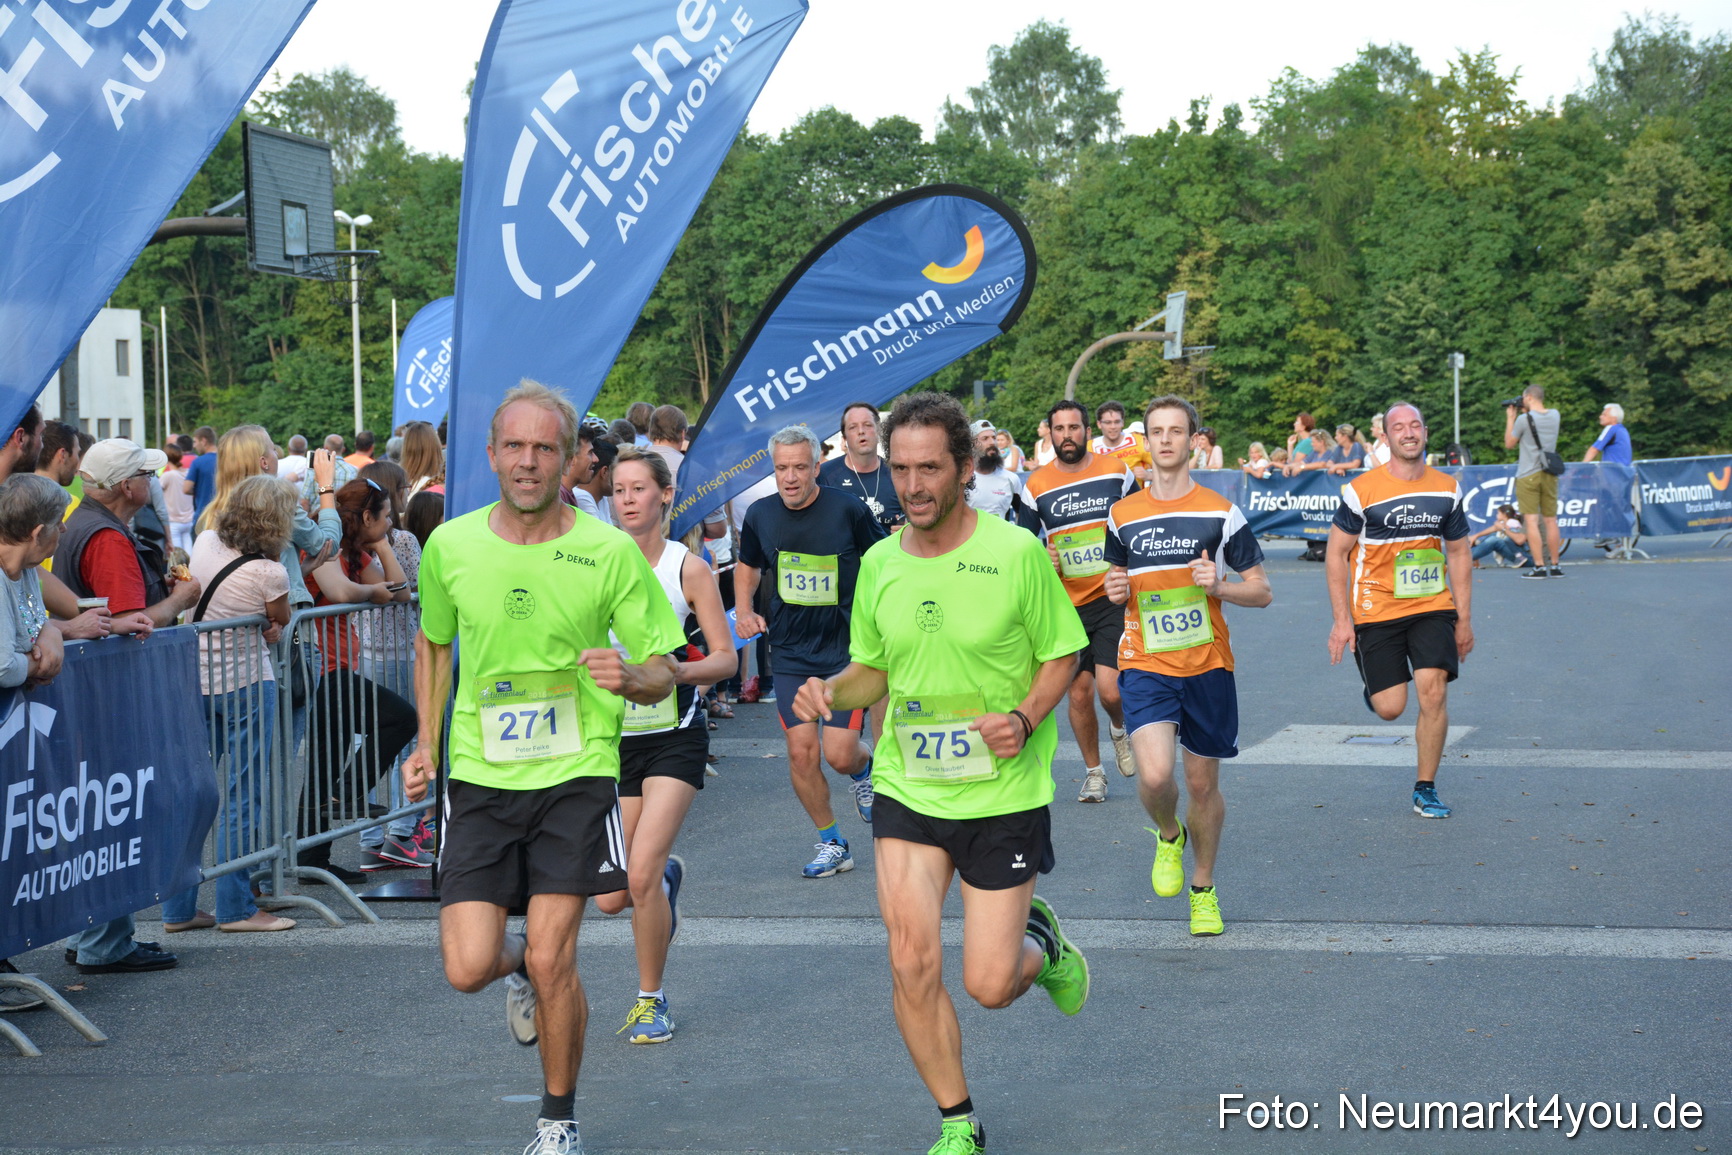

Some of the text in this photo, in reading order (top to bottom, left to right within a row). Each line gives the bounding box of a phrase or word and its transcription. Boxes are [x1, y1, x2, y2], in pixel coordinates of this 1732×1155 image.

[101, 0, 211, 131] AUT
[547, 0, 728, 248] Fische
[614, 4, 754, 244] AUTOMOBILE
[871, 274, 1015, 366] Druck und Medien
[733, 288, 945, 423] Frischmann
[1249, 490, 1341, 512] Frischmann
[1641, 481, 1713, 504] Frischmann
[1061, 496, 1109, 514] Fischer
[1066, 505, 1107, 518] AUTOMOBILE
[1301, 511, 1326, 521] Druck
[1396, 511, 1443, 526] Fischer
[1141, 535, 1199, 551] Fischer
[1147, 548, 1195, 558] AUTOMOBILE
[567, 553, 596, 568] DEKRA
[1063, 546, 1103, 566] 1649
[969, 563, 999, 576] DEKRA
[1400, 566, 1440, 584] 1644
[784, 572, 830, 592] 1311
[1148, 608, 1203, 635] 1639
[498, 706, 558, 741] 271
[911, 729, 971, 760] 275
[1, 760, 155, 862] Fischer
[12, 836, 142, 907] AUTOMOBILE
